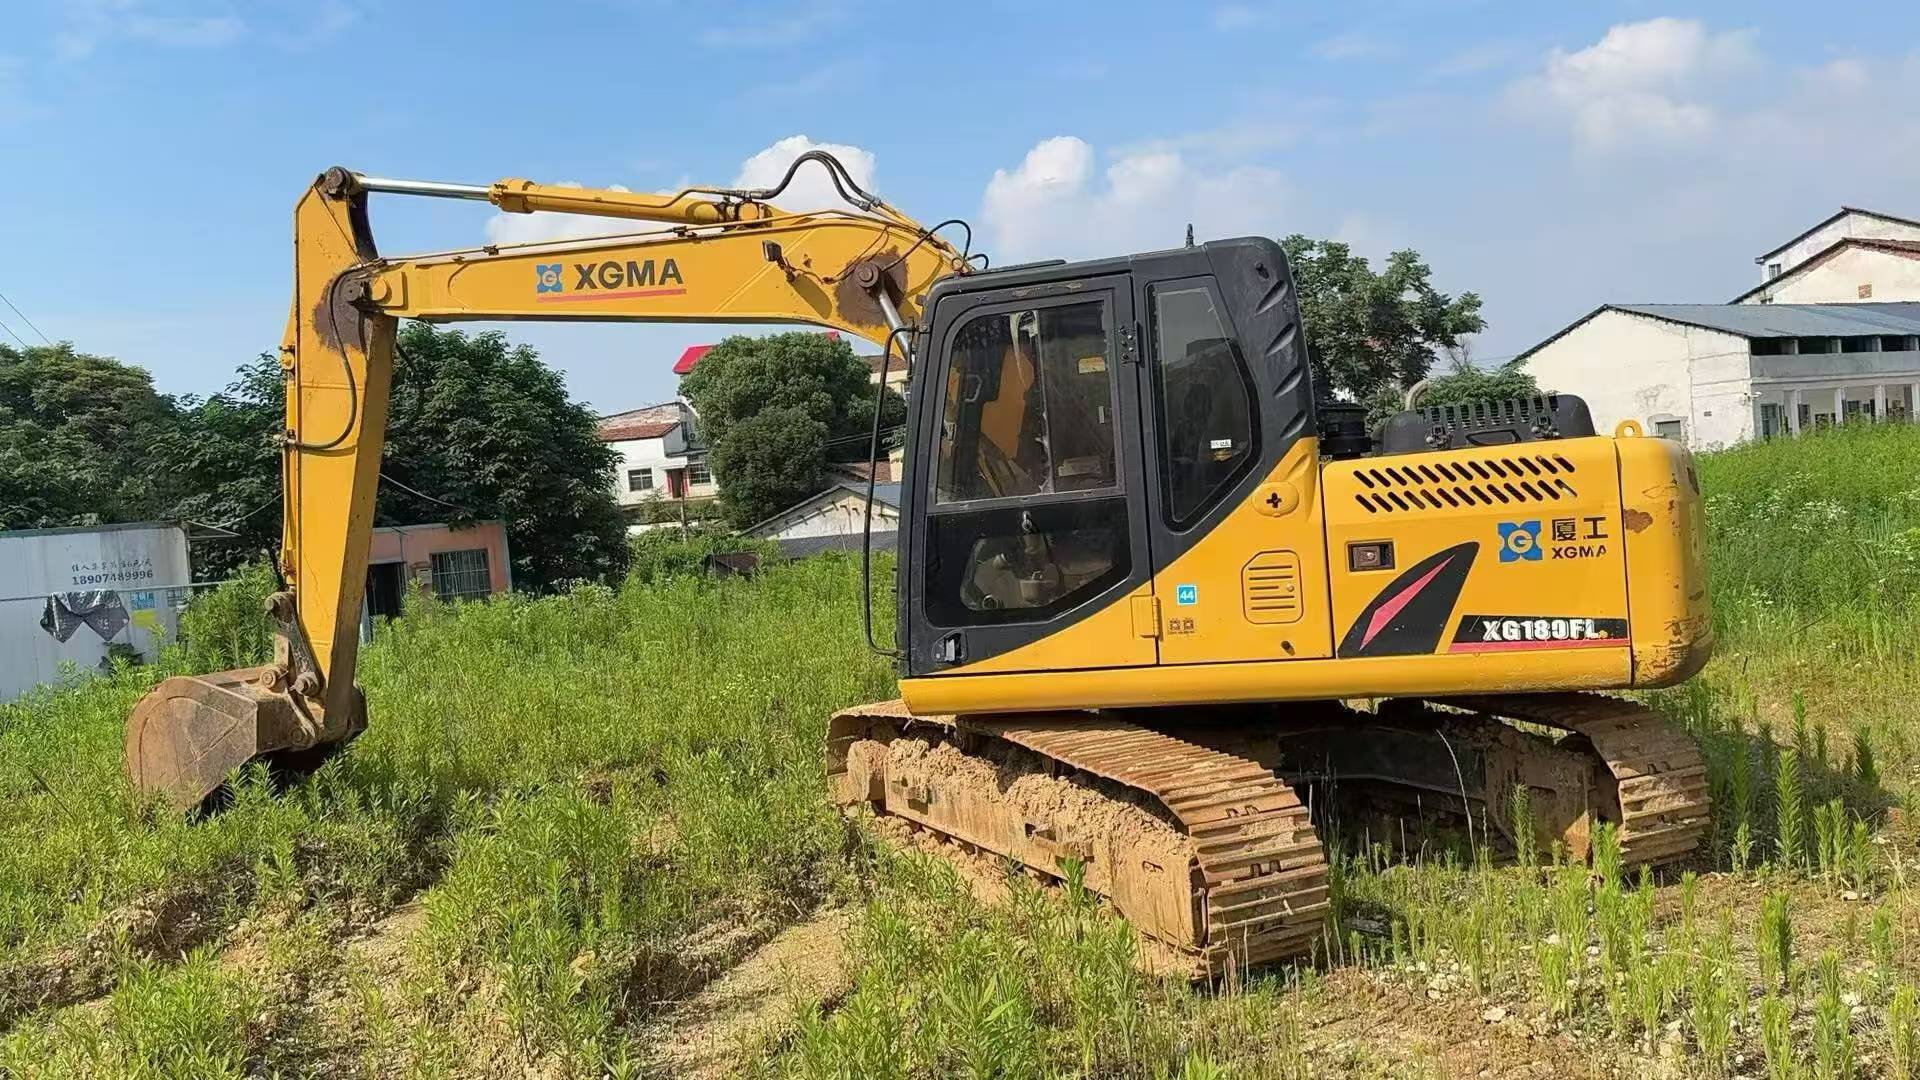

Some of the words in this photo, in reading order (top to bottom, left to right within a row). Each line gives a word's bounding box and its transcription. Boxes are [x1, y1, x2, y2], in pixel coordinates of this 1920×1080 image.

[573, 258, 684, 290] XGMA
[1552, 517, 1608, 542] 厦工
[1551, 545, 1607, 560] XGMA
[1179, 590, 1195, 601] 44
